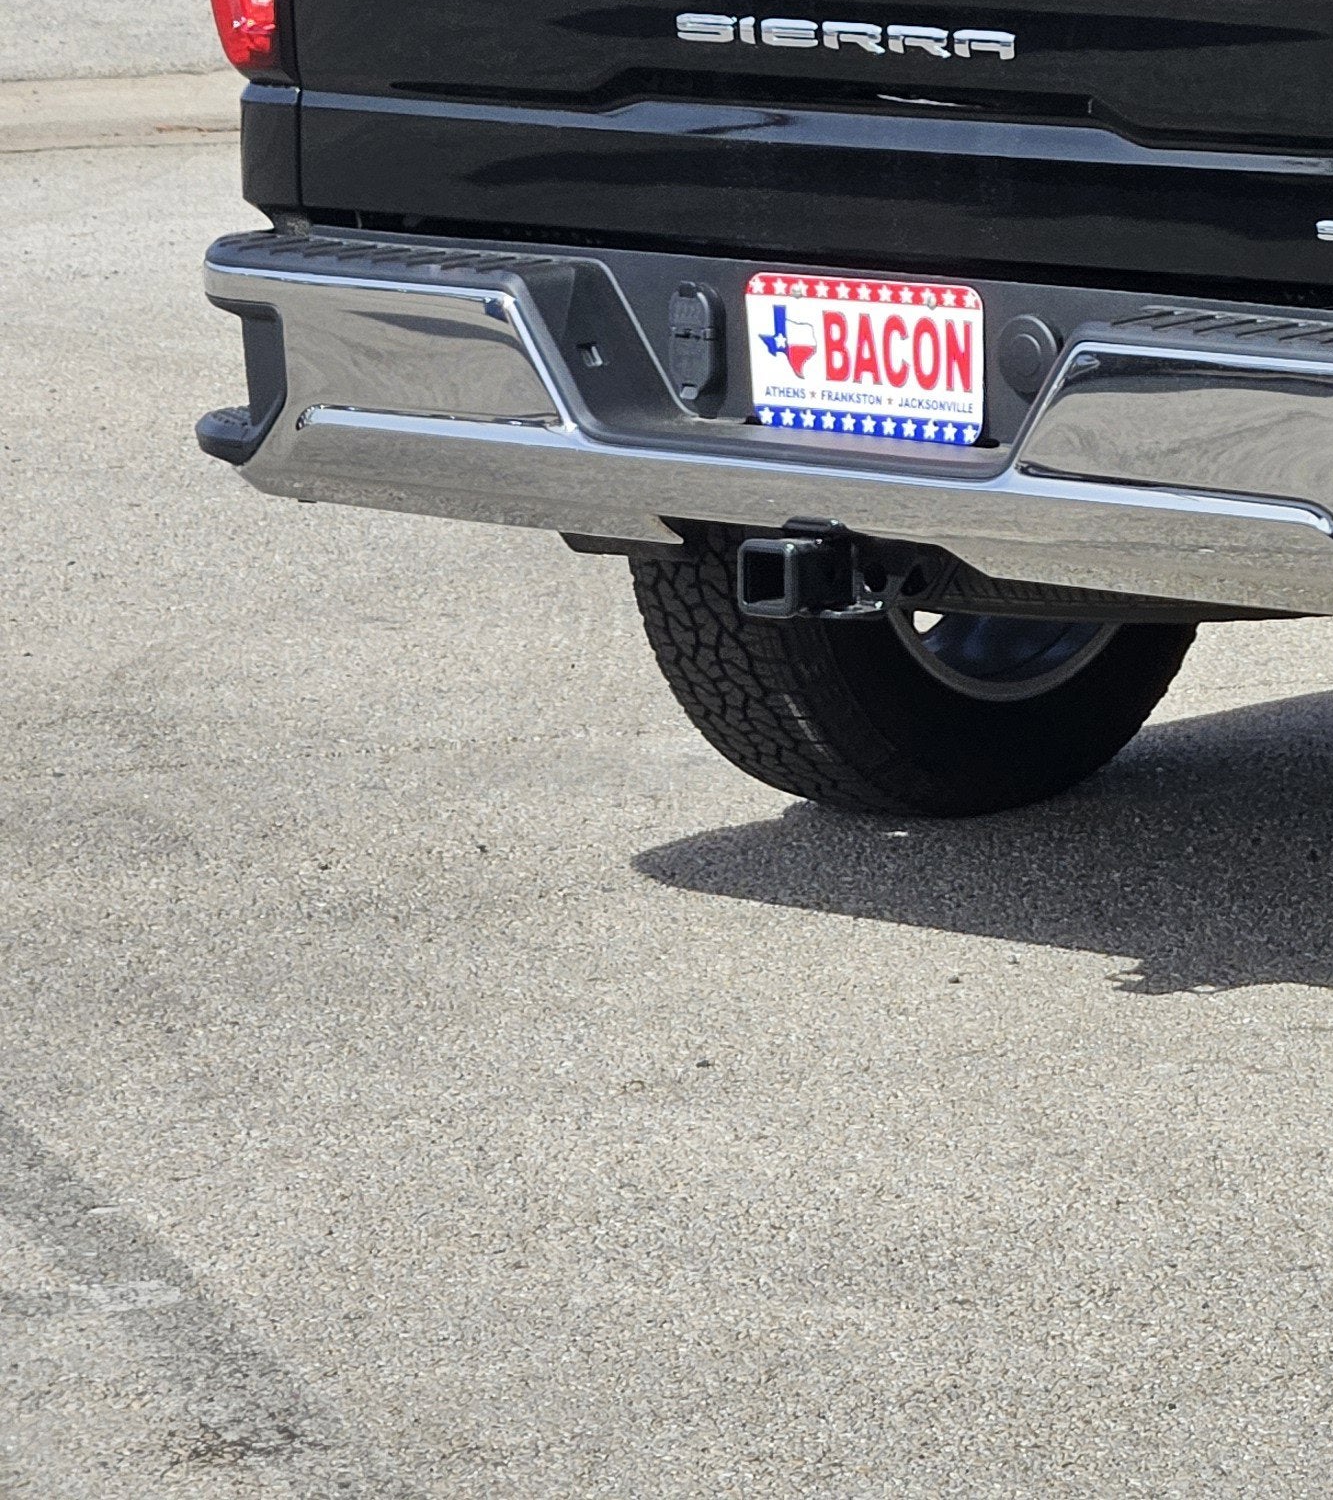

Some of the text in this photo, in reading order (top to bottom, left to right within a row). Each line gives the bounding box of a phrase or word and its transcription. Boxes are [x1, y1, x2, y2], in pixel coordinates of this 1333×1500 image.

[674, 12, 1017, 62] SIERRA
[821, 309, 974, 394] BACON
[764, 386, 974, 414] ATHENS FRANKSTON JACKSONVILLE
